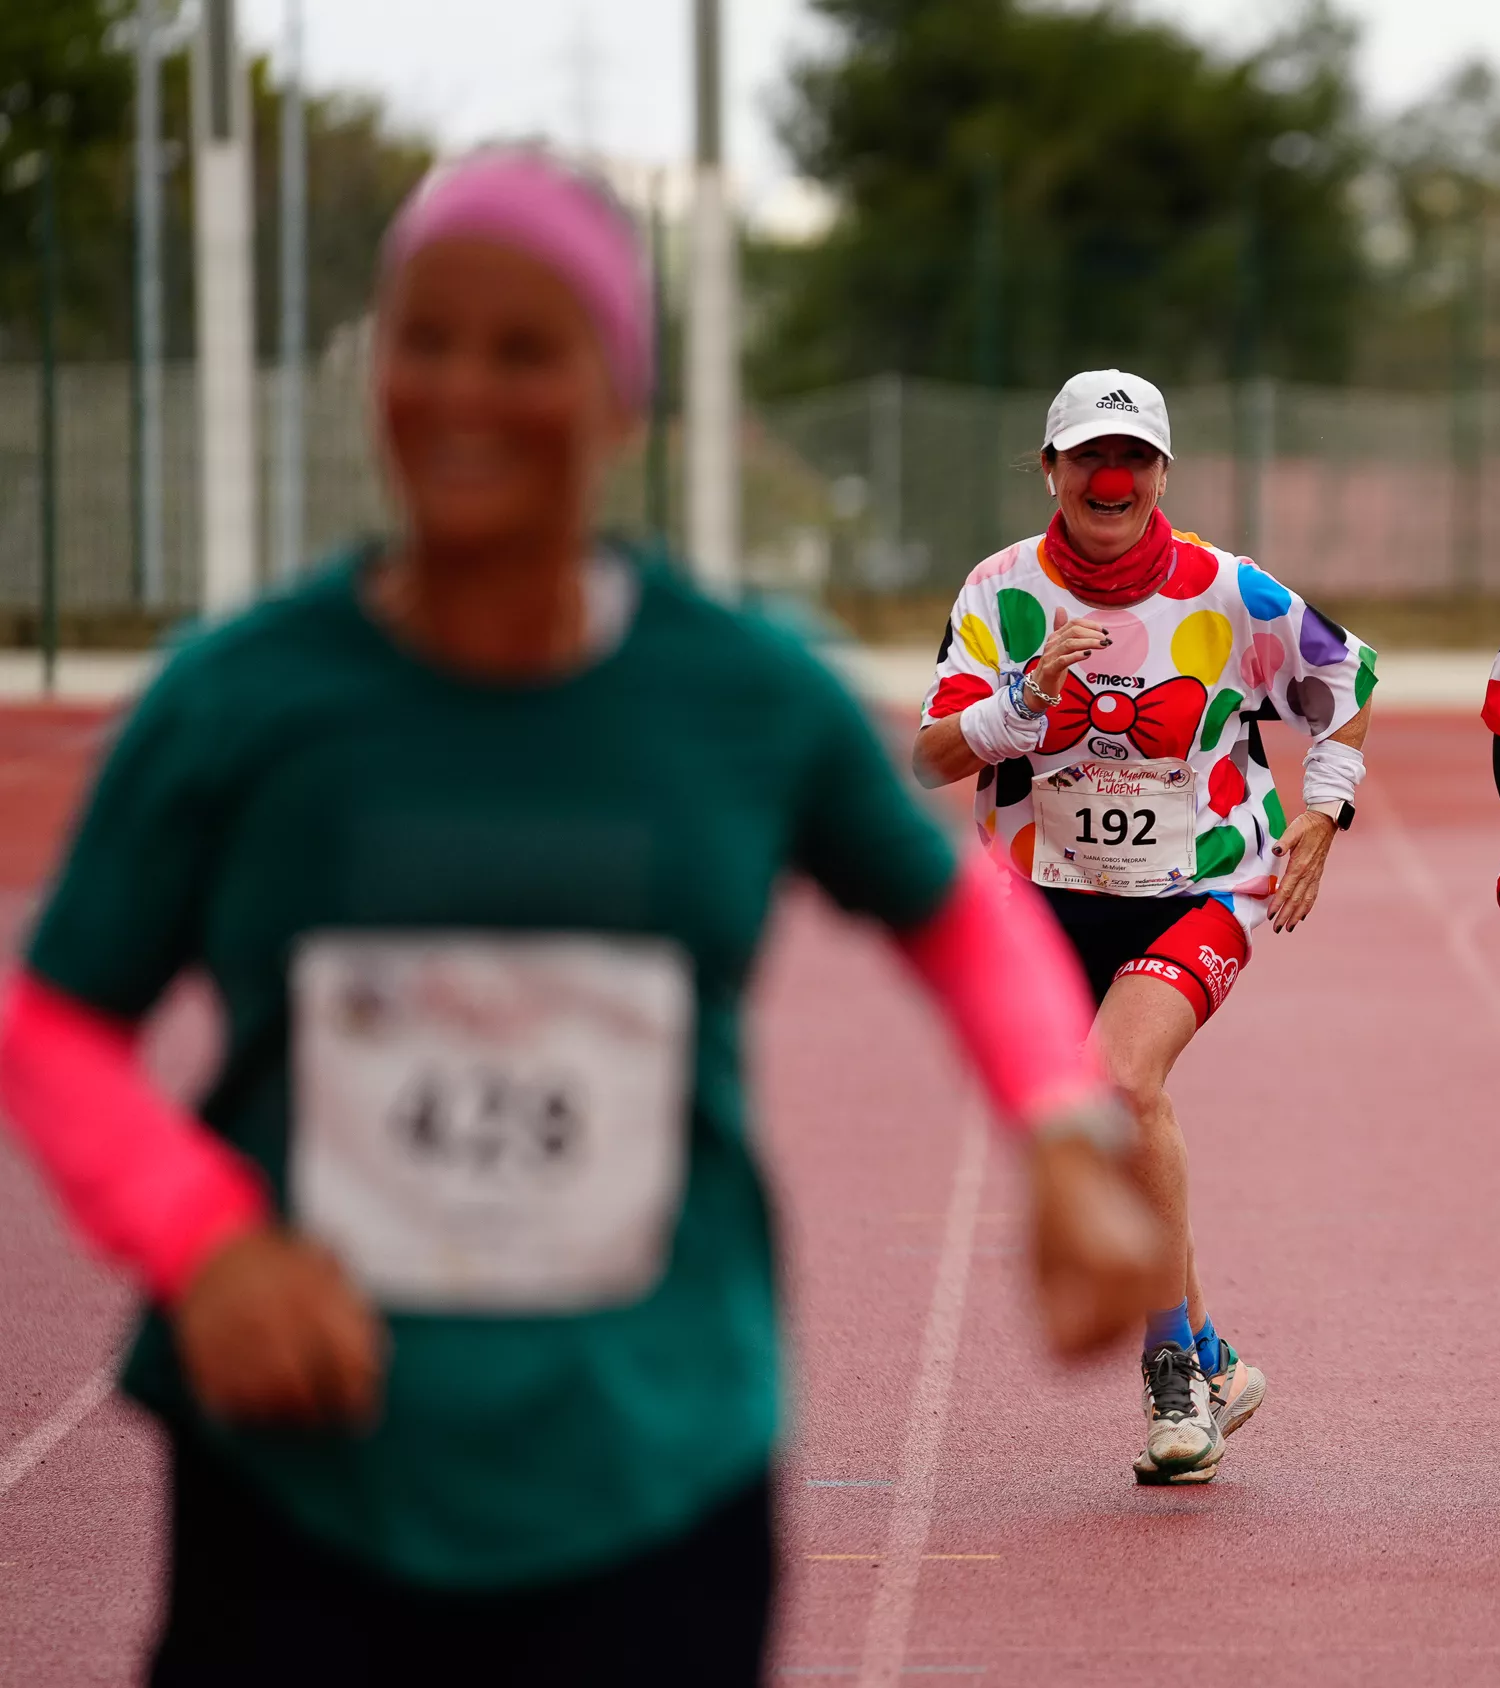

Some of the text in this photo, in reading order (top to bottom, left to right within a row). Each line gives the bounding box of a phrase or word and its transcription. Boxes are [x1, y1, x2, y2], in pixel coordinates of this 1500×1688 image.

[1096, 400, 1139, 414] adidas
[1086, 672, 1132, 687] emec
[1097, 779, 1148, 796] LUCENA
[1075, 807, 1157, 846] 192
[1198, 950, 1223, 986] IBIZA
